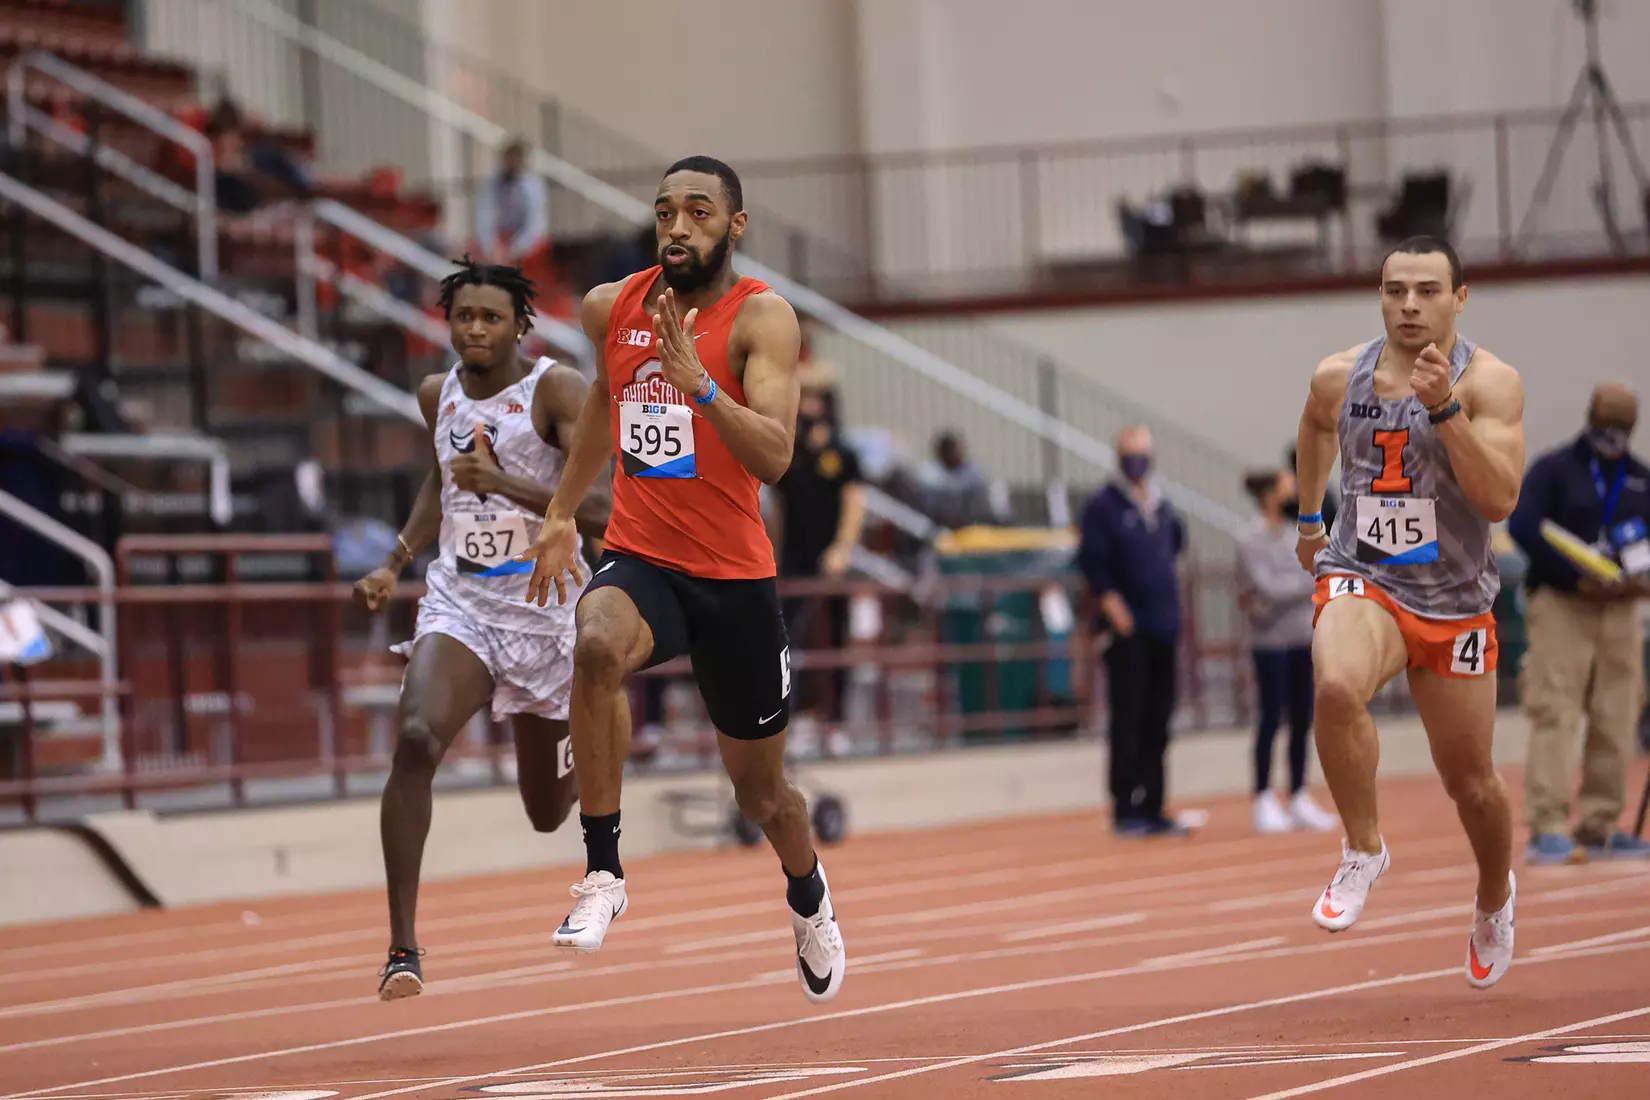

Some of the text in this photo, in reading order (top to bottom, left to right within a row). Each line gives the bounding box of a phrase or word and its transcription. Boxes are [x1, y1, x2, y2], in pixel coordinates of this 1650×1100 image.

[629, 423, 682, 457] 595
[465, 529, 515, 559] 637
[1367, 516, 1423, 545] 415
[1335, 578, 1358, 593] 4
[1458, 631, 1480, 672] 4
